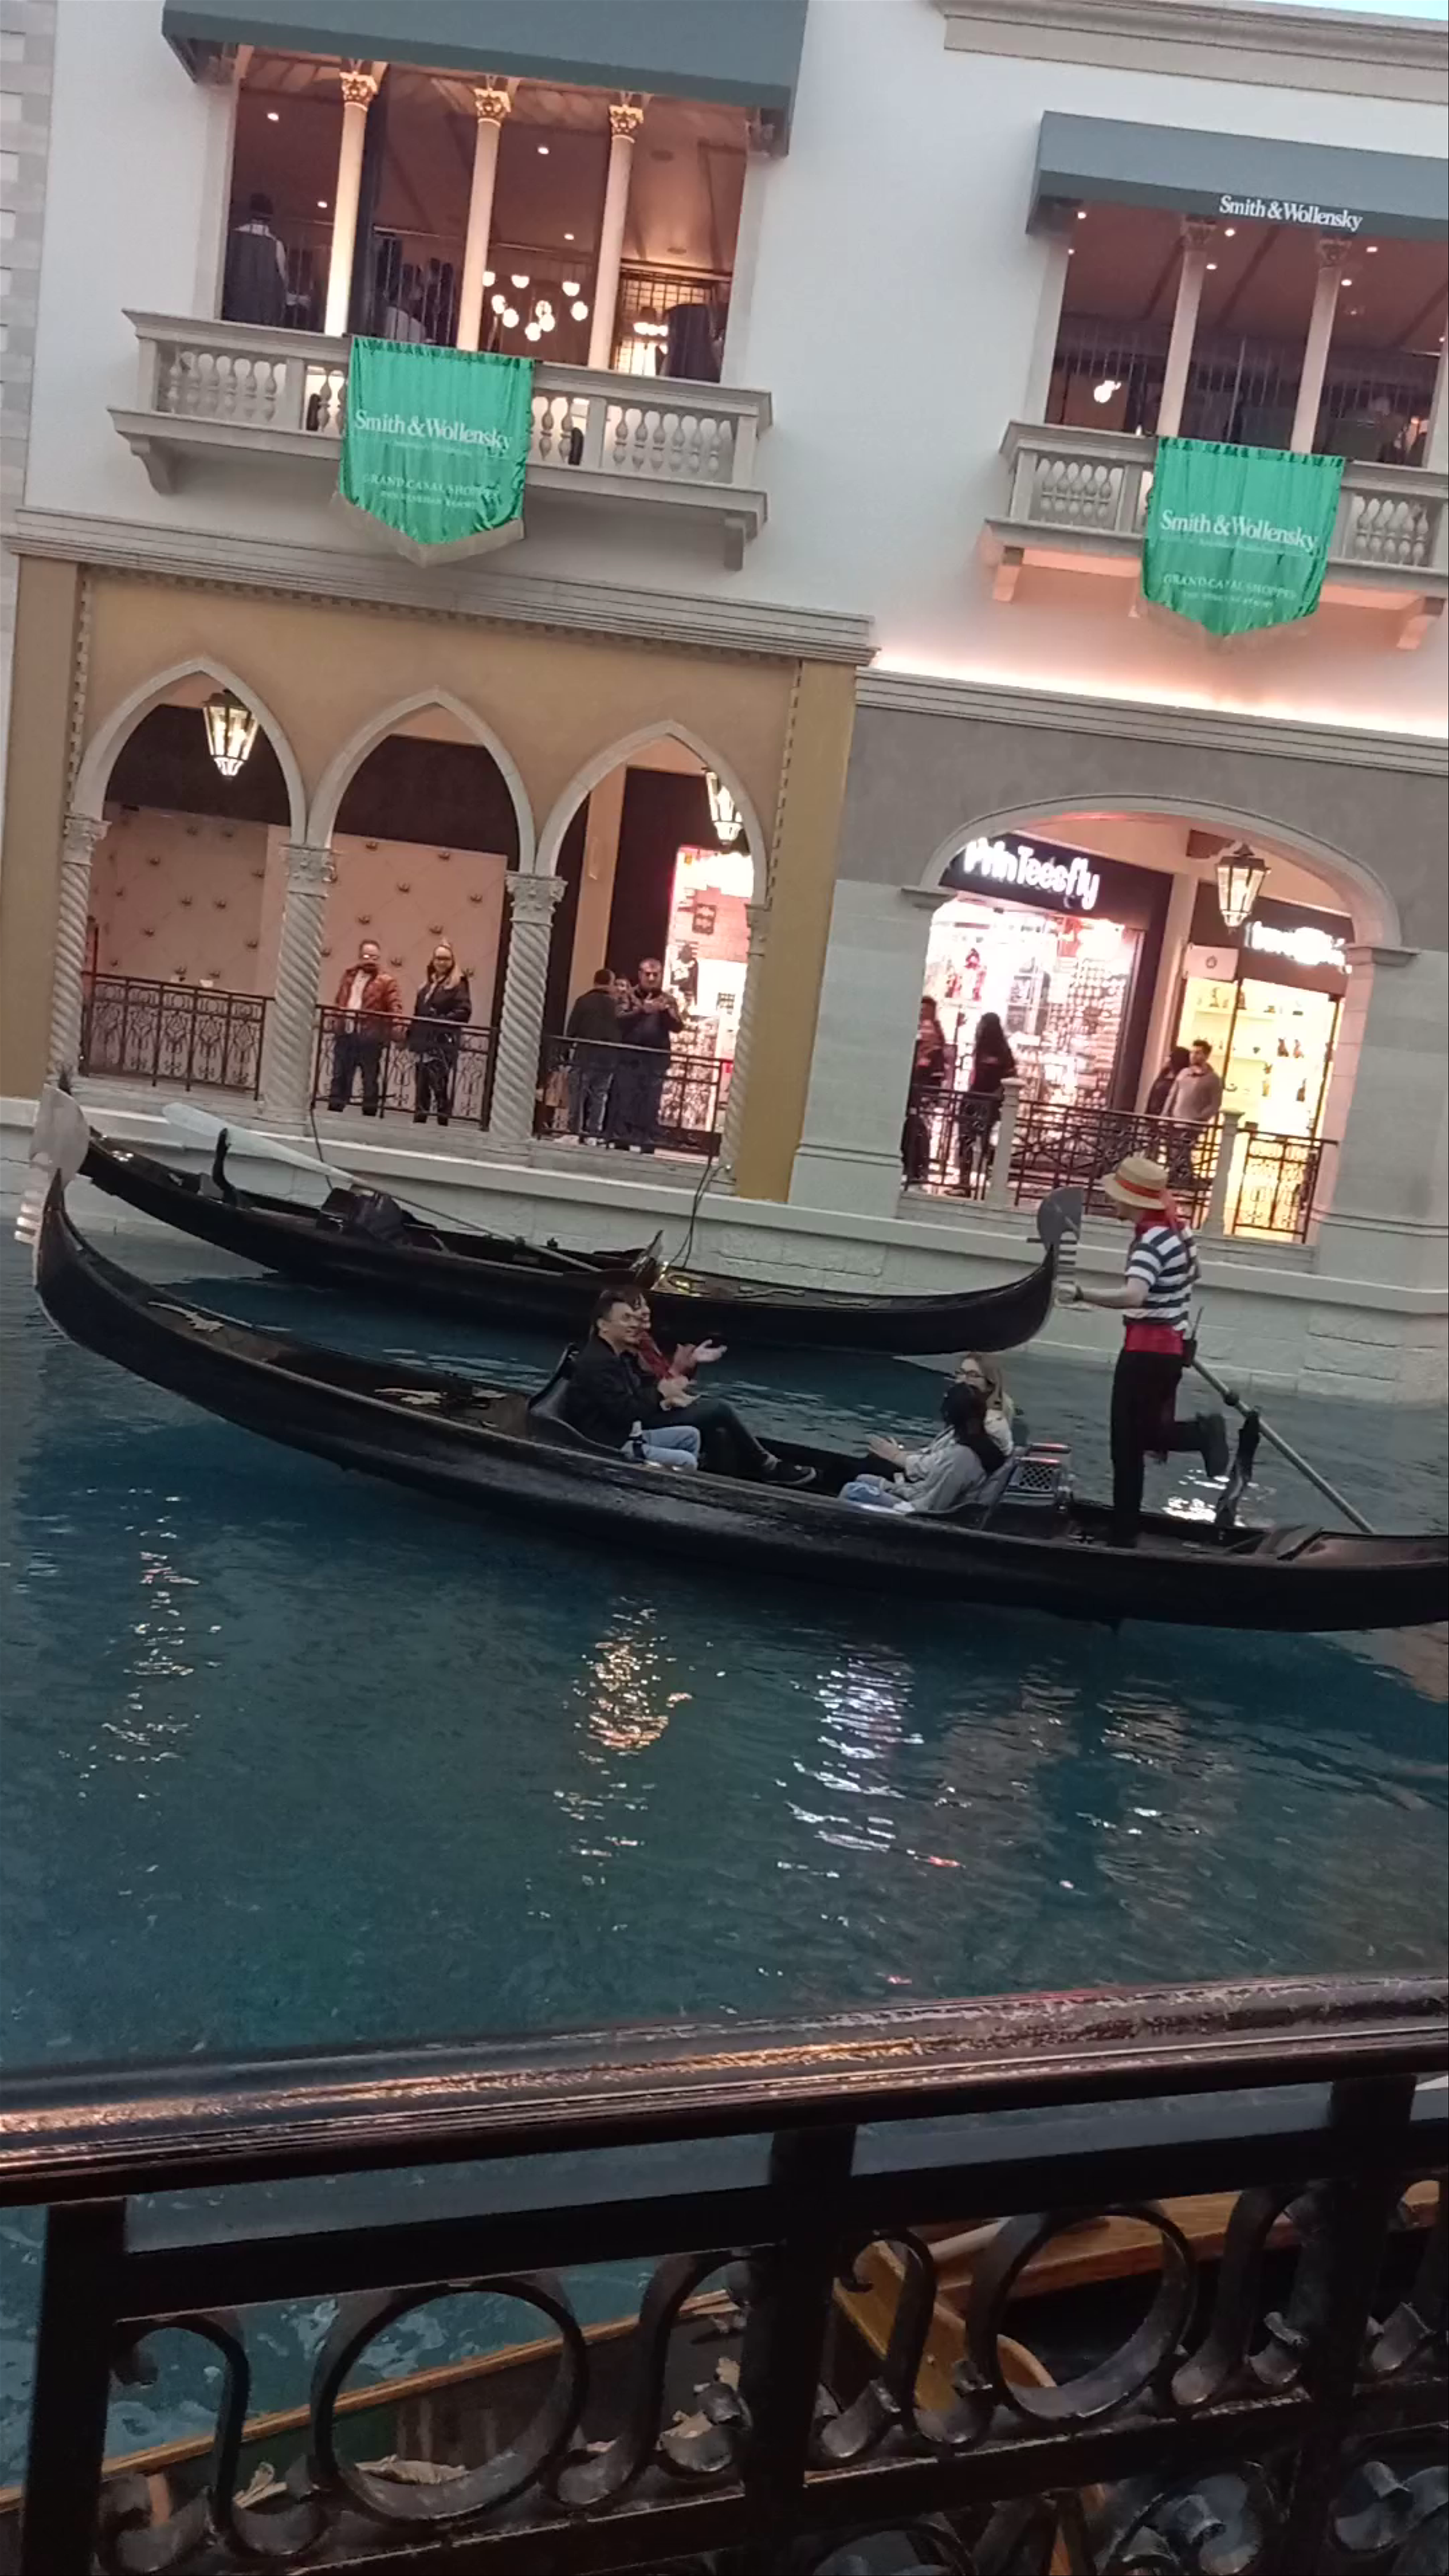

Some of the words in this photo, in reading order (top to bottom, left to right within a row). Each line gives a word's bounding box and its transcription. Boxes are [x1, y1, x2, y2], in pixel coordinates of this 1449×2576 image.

[1219, 195, 1266, 218] Smith
[1267, 200, 1283, 220] &
[1283, 202, 1363, 232] Wollensky
[355, 410, 405, 435] Smith
[407, 415, 425, 438] &
[426, 418, 512, 451] Wollensky
[1160, 509, 1211, 533] Smith
[1213, 514, 1231, 537] &
[1231, 515, 1319, 552] Wollensky
